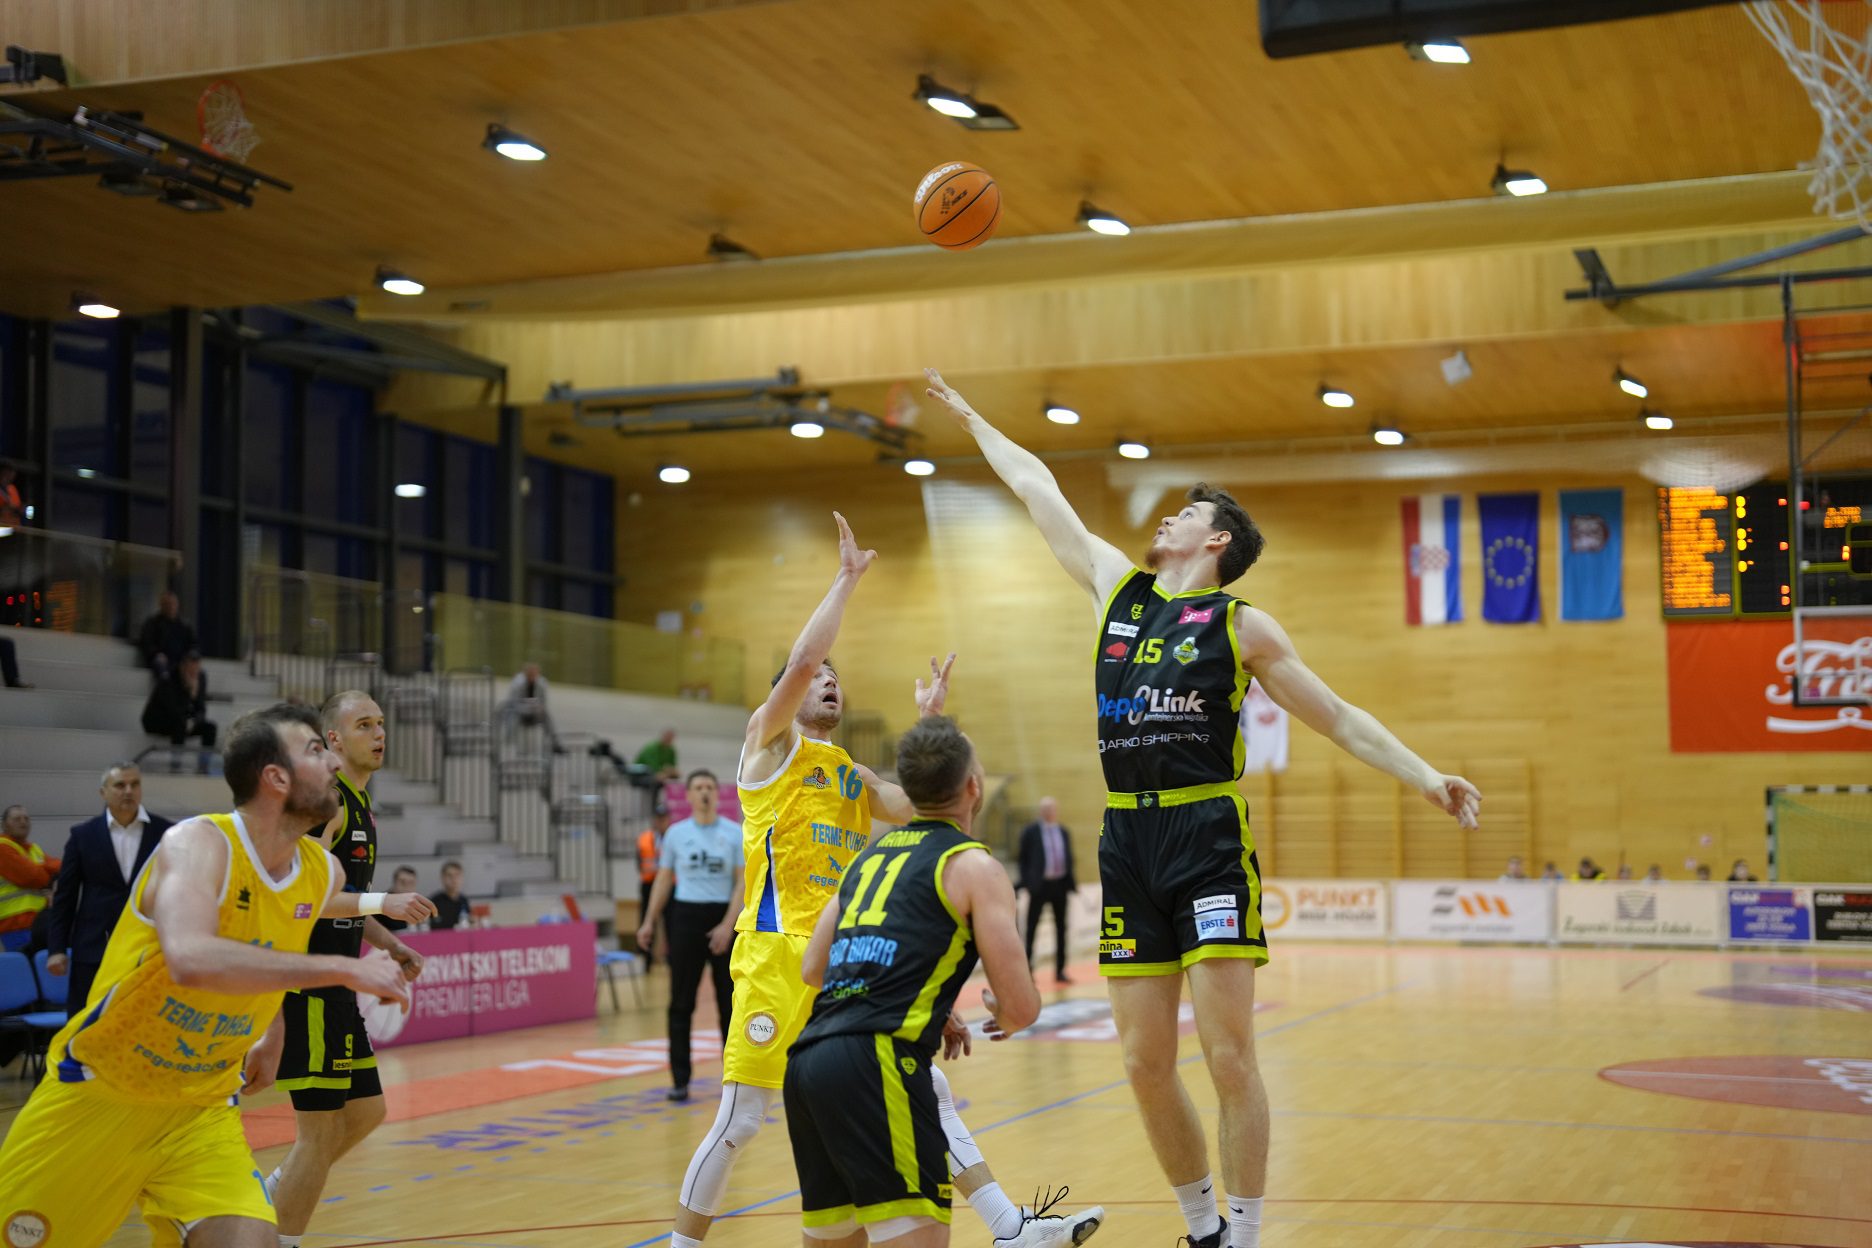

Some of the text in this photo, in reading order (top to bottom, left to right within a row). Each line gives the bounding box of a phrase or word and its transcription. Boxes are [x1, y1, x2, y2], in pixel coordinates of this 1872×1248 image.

[1133, 638, 1165, 664] 15
[1142, 732, 1210, 746] SHIPPING
[836, 764, 863, 801] 16
[811, 822, 842, 848] TERME
[838, 851, 912, 930] 11
[1197, 898, 1234, 909] ADMIRAL
[1099, 906, 1124, 937] 5
[1201, 918, 1226, 930] ERSTE
[416, 944, 571, 986] HRVATSKI TELEKOM
[414, 978, 531, 1018] PREMIJER LIGA
[750, 1023, 774, 1034] PUNKT
